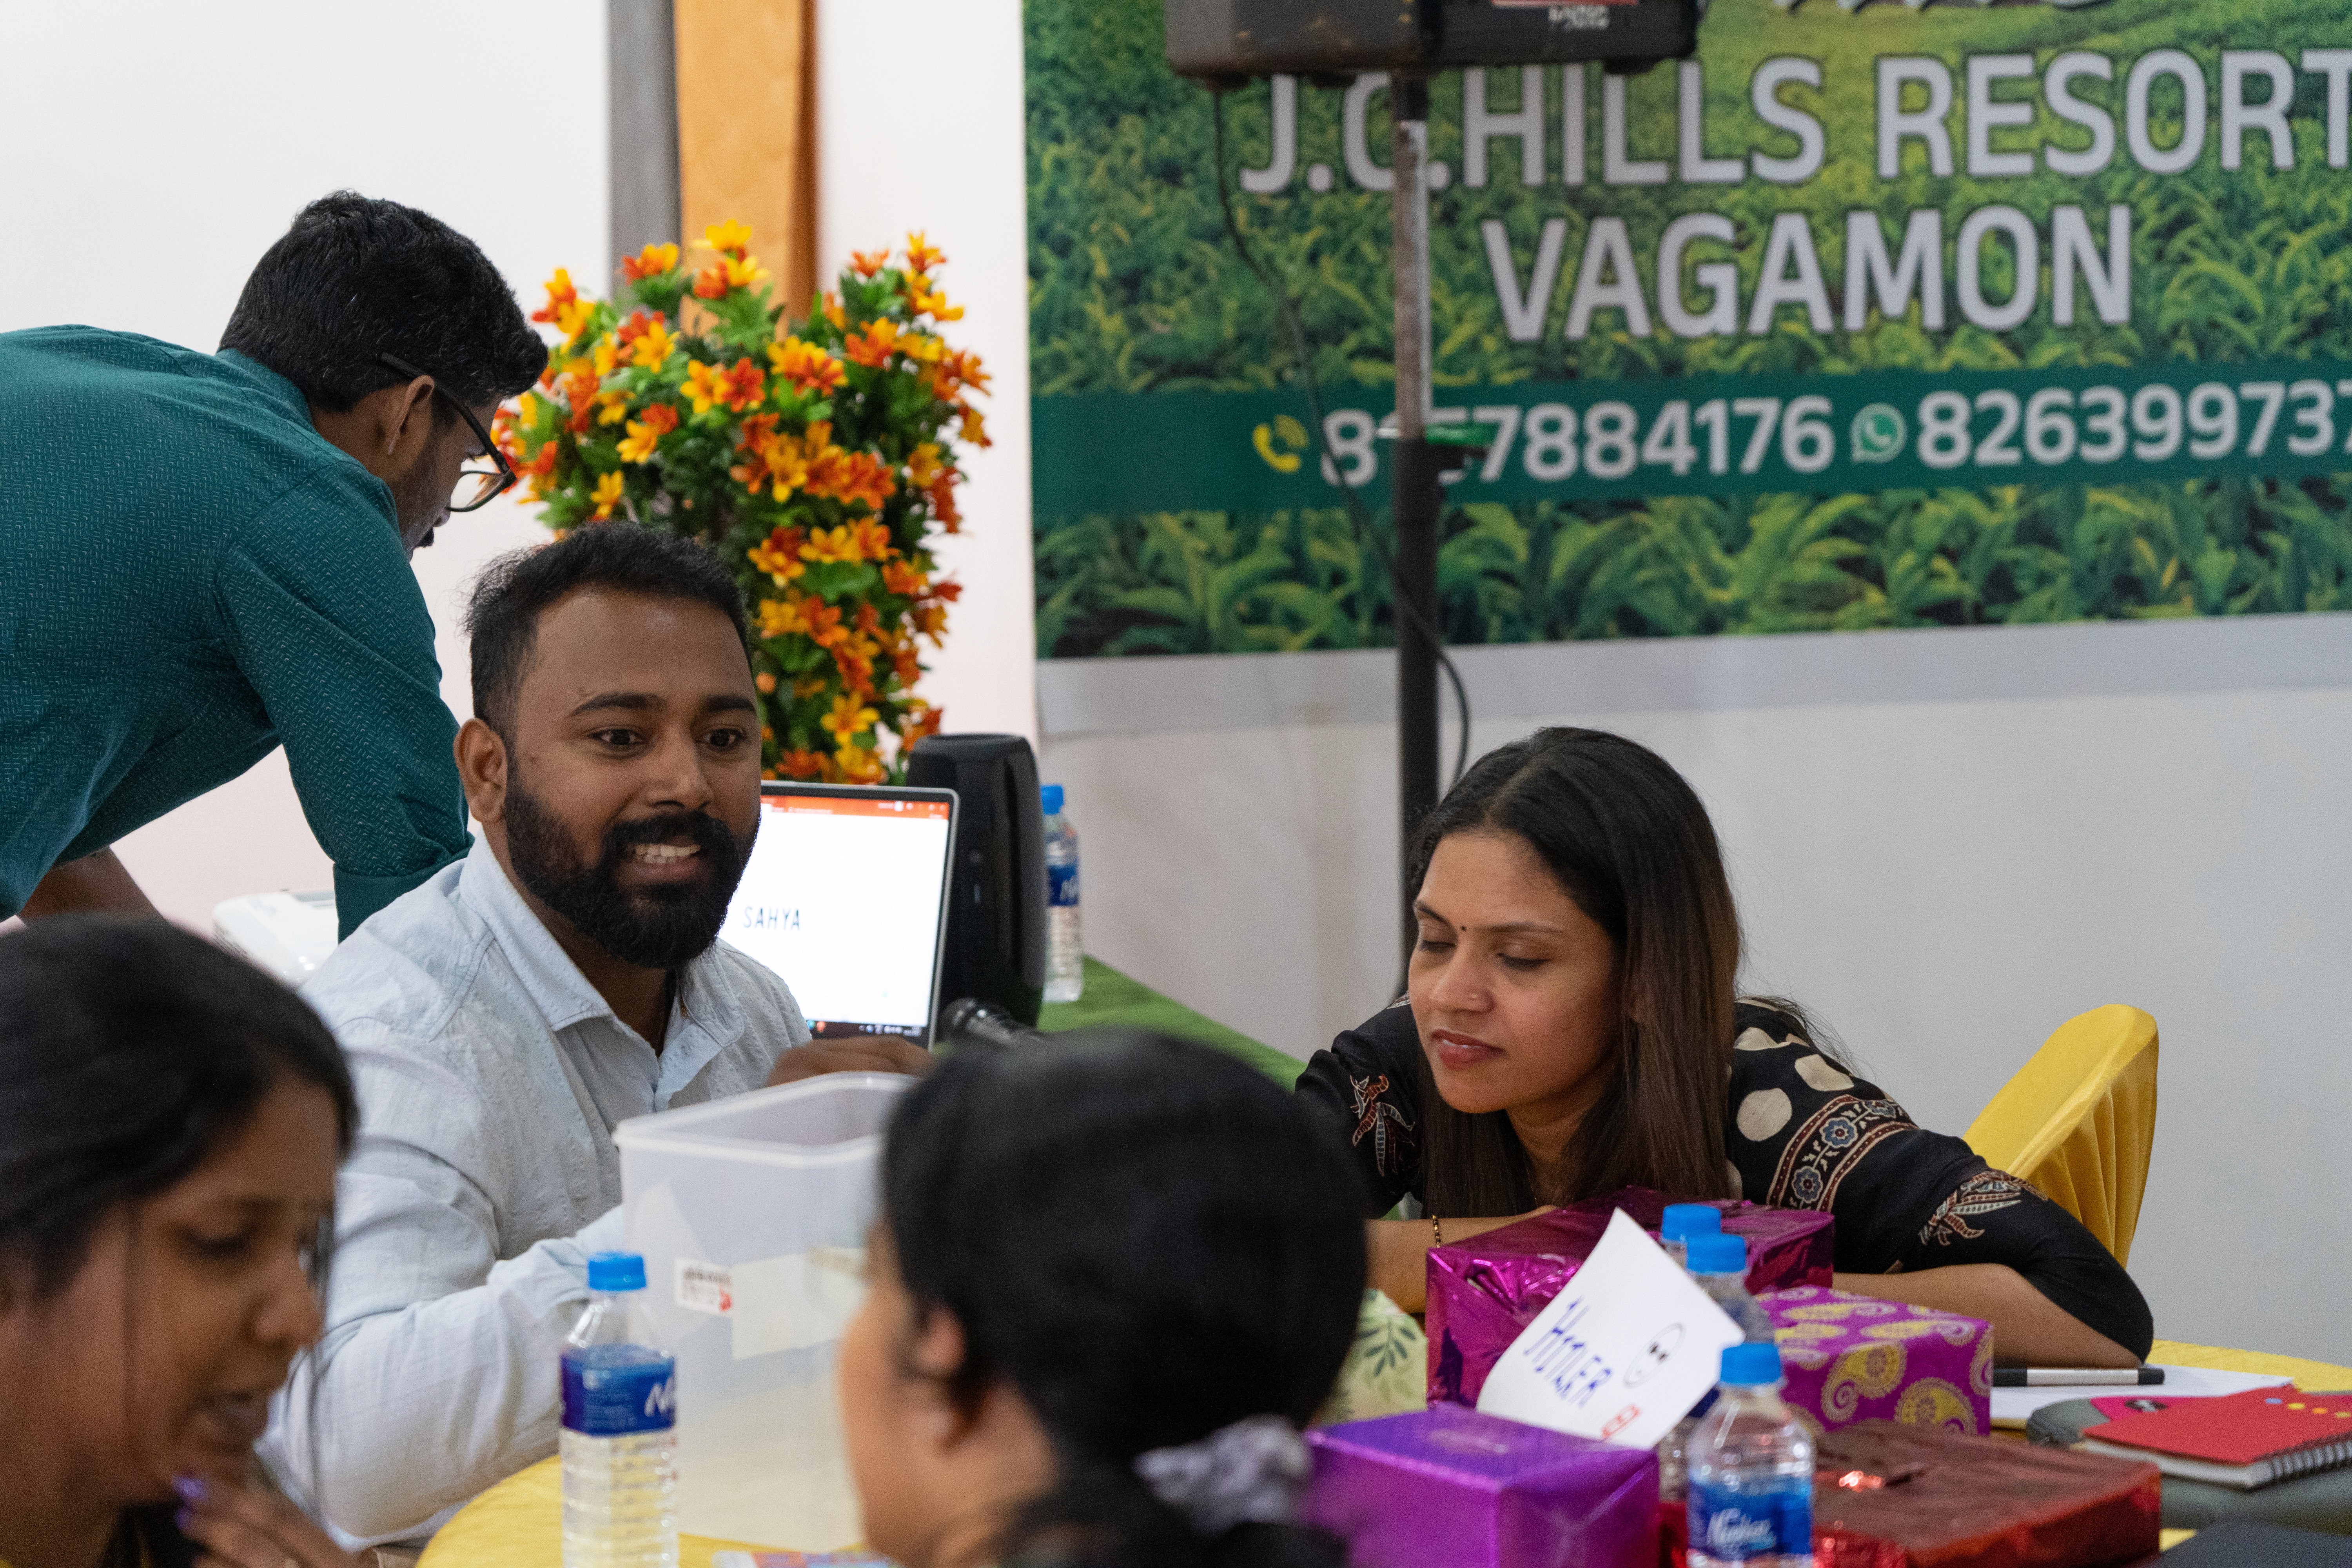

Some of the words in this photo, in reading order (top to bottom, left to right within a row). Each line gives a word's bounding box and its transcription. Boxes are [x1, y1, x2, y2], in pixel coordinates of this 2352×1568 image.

[1876, 49, 2352, 178] RESORT
[1481, 204, 2131, 340] VAGAMON
[1321, 395, 1835, 487] 87884176
[744, 906, 800, 931] SAHYA
